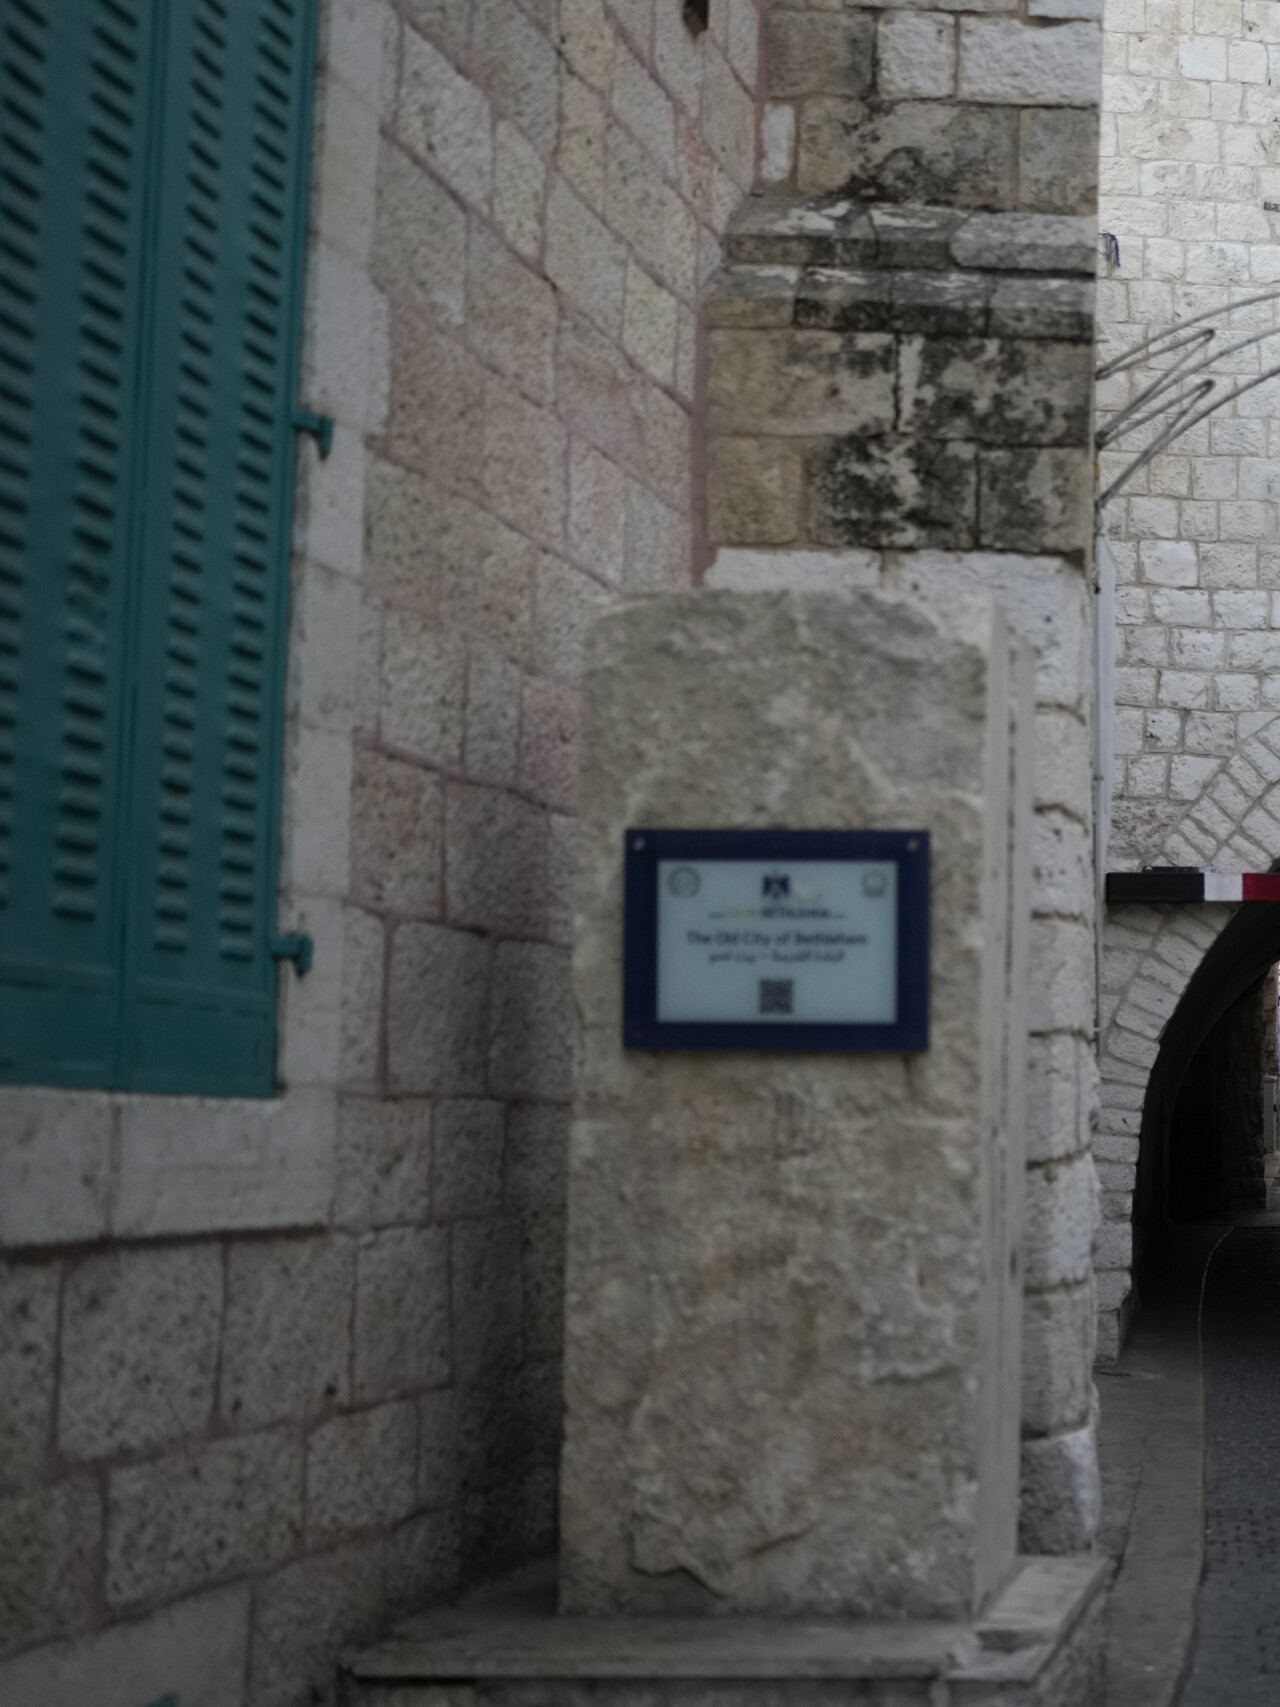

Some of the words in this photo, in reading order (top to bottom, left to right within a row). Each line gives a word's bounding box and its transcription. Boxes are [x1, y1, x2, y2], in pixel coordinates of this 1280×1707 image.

[687, 930, 713, 946] The
[715, 930, 740, 946] Old
[742, 930, 771, 950] City
[775, 930, 792, 946] of
[793, 930, 870, 946] Bethlehem
